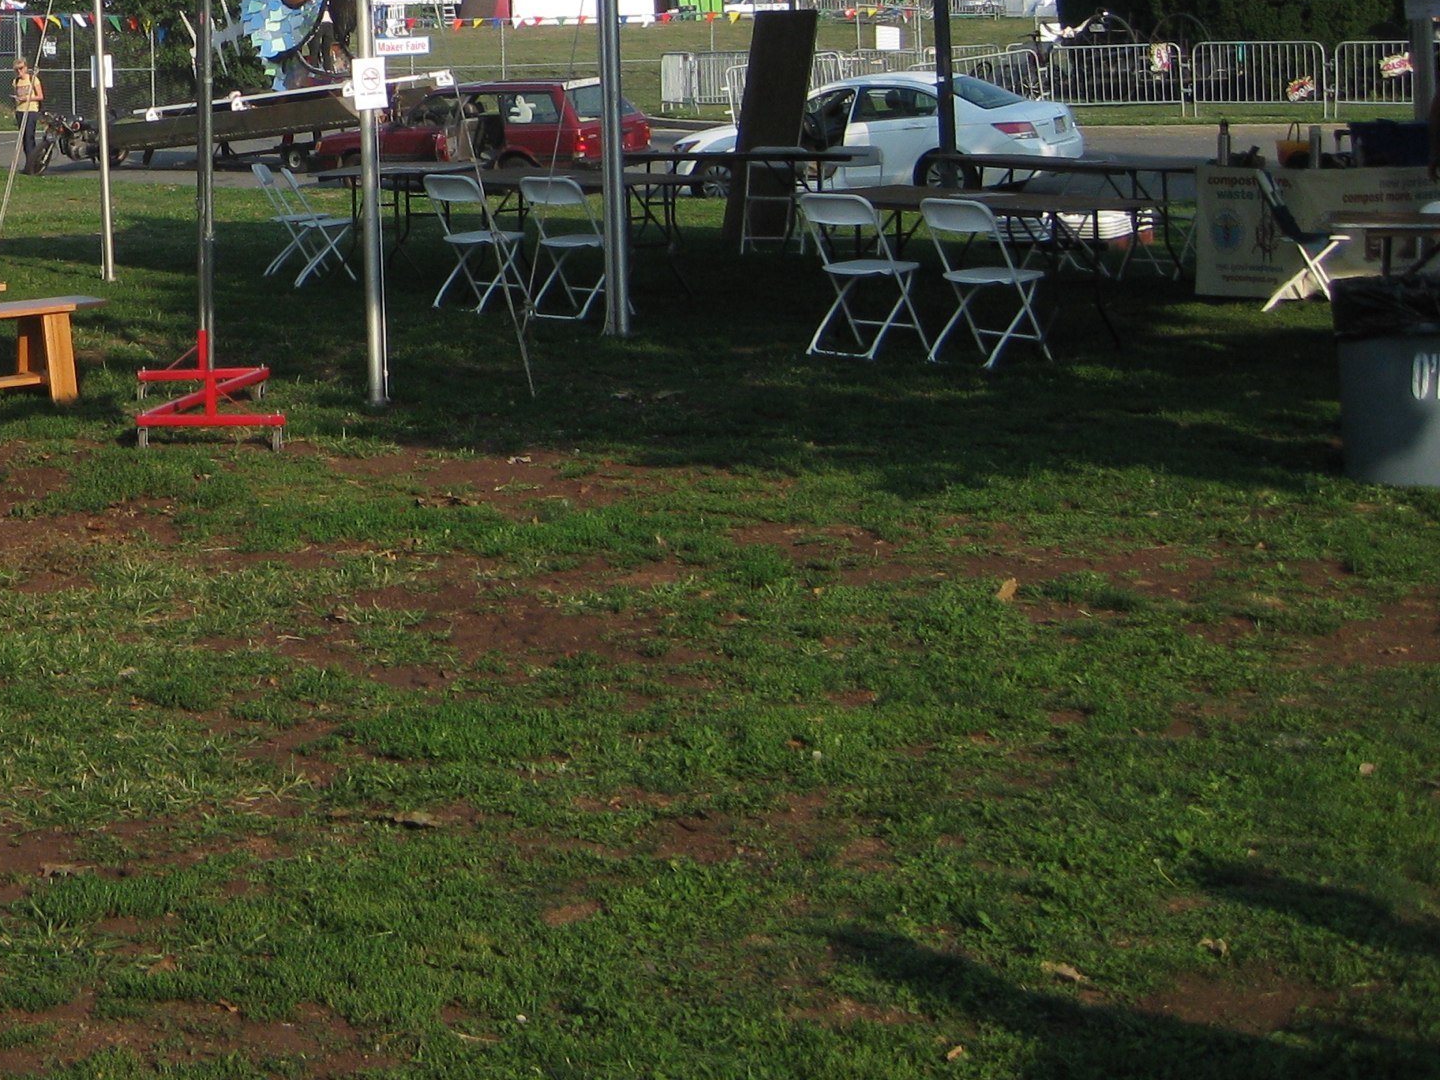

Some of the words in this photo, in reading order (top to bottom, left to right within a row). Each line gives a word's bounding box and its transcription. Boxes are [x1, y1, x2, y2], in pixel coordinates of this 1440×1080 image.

[377, 41, 405, 53] Maker
[406, 39, 427, 51] Faire
[1207, 176, 1257, 188] compost
[1216, 190, 1254, 200] waste
